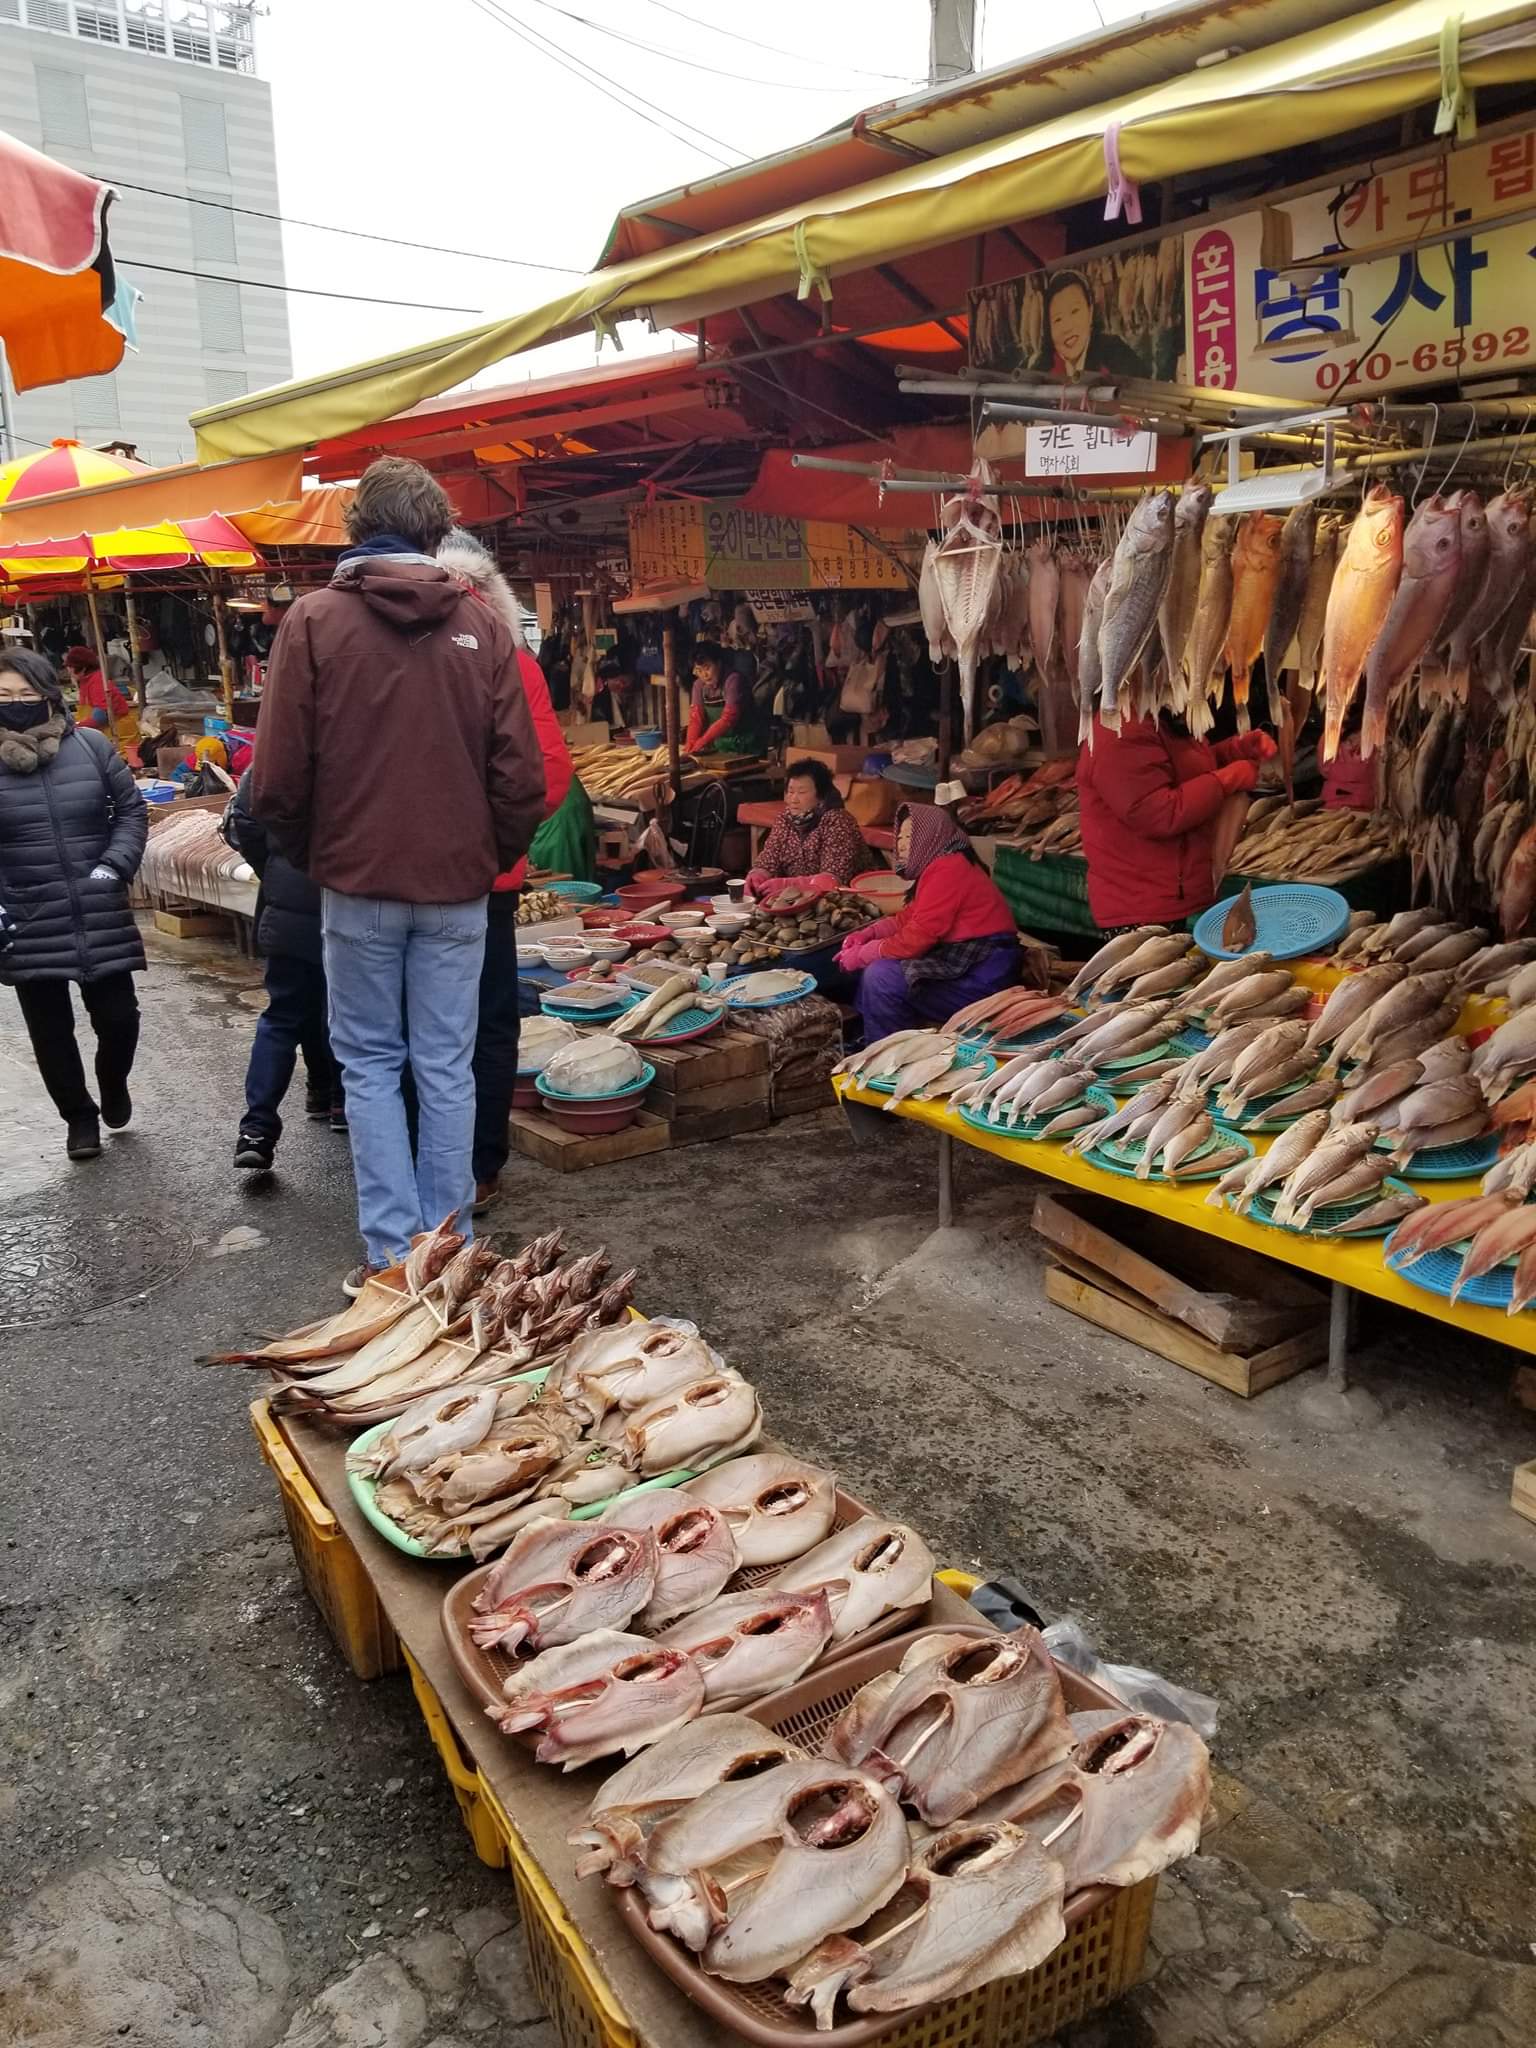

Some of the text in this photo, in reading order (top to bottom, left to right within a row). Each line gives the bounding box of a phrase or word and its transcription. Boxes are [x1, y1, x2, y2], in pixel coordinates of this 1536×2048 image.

[1343, 164, 1455, 232] 카드
[1195, 244, 1232, 391] 혼수용
[1039, 426, 1075, 449] 카드
[1040, 455, 1080, 474] 명자상회
